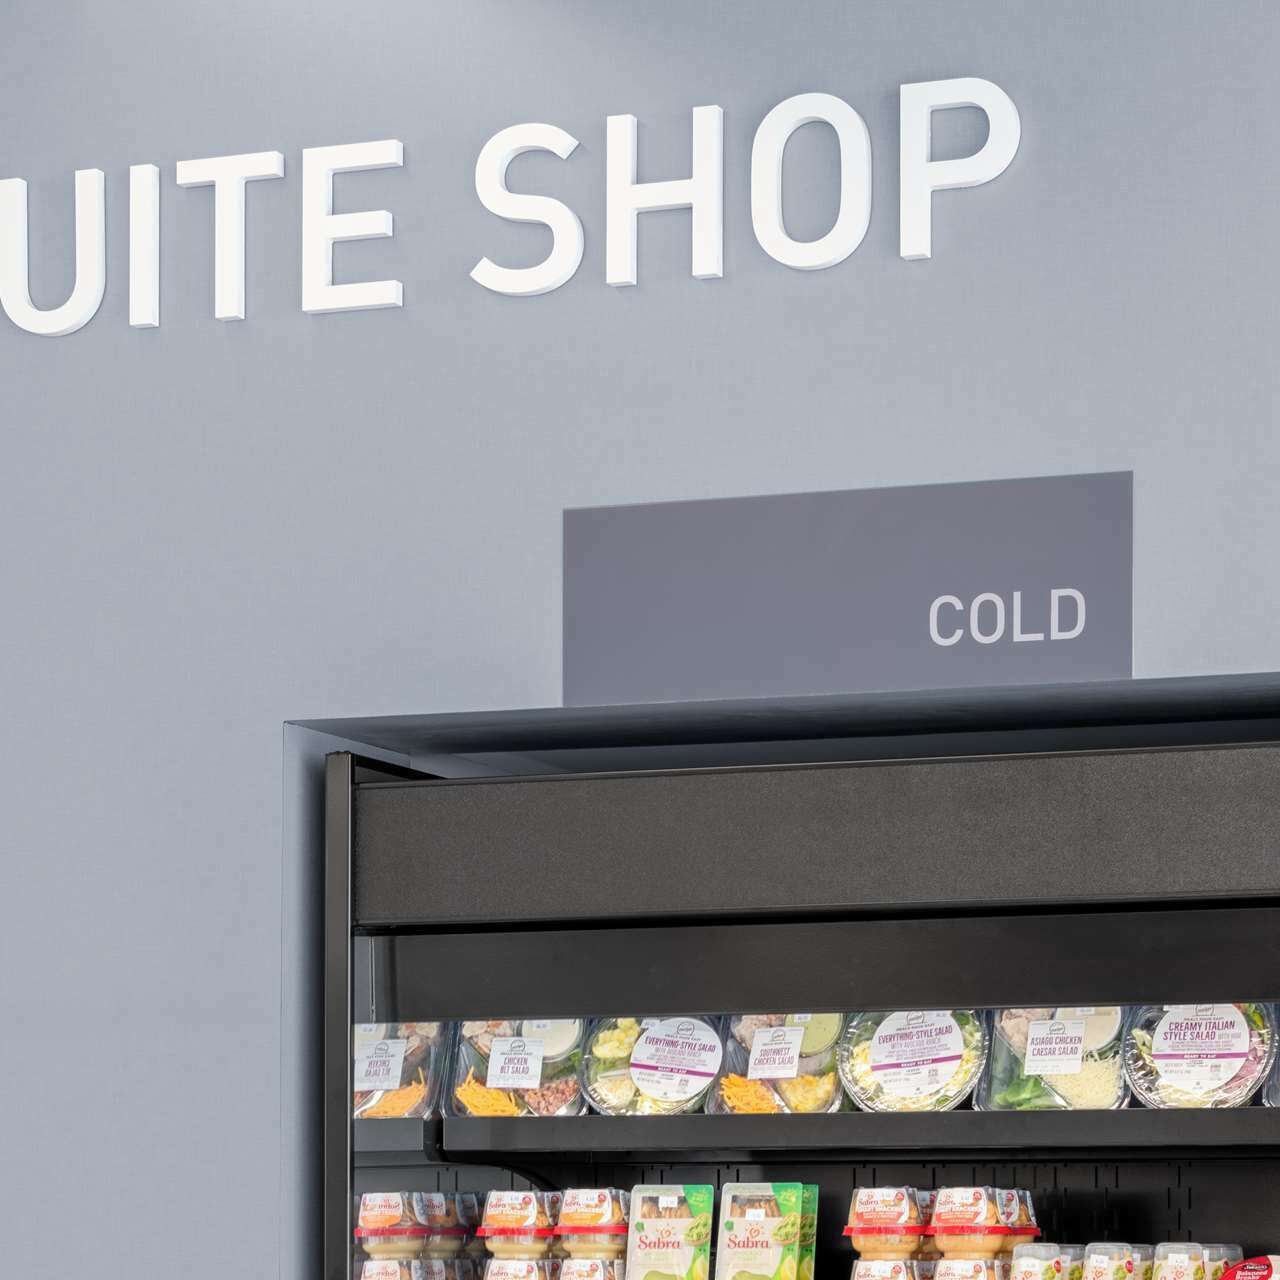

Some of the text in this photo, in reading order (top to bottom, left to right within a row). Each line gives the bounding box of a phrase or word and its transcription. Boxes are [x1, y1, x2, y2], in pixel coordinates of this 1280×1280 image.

[468, 77, 1022, 296] SHOP
[929, 588, 1086, 646] COLD
[933, 1025, 953, 1037] SALAD
[1168, 1020, 1235, 1032] CREAMY ITALIAN
[1030, 1036, 1082, 1045] ASIAGO CHICKEN
[1162, 1031, 1216, 1041] STYLE SALAD
[697, 1042, 716, 1053] SALAD
[759, 1047, 790, 1057] SOUTHWEST
[1032, 1046, 1078, 1057] CAESAR SALAD
[504, 1056, 528, 1065] CHICKEN
[753, 1056, 794, 1066] CHICKEN SALAD
[511, 1065, 529, 1074] SALAD
[638, 1234, 680, 1249] Sabra
[727, 1233, 769, 1249] Sabra
